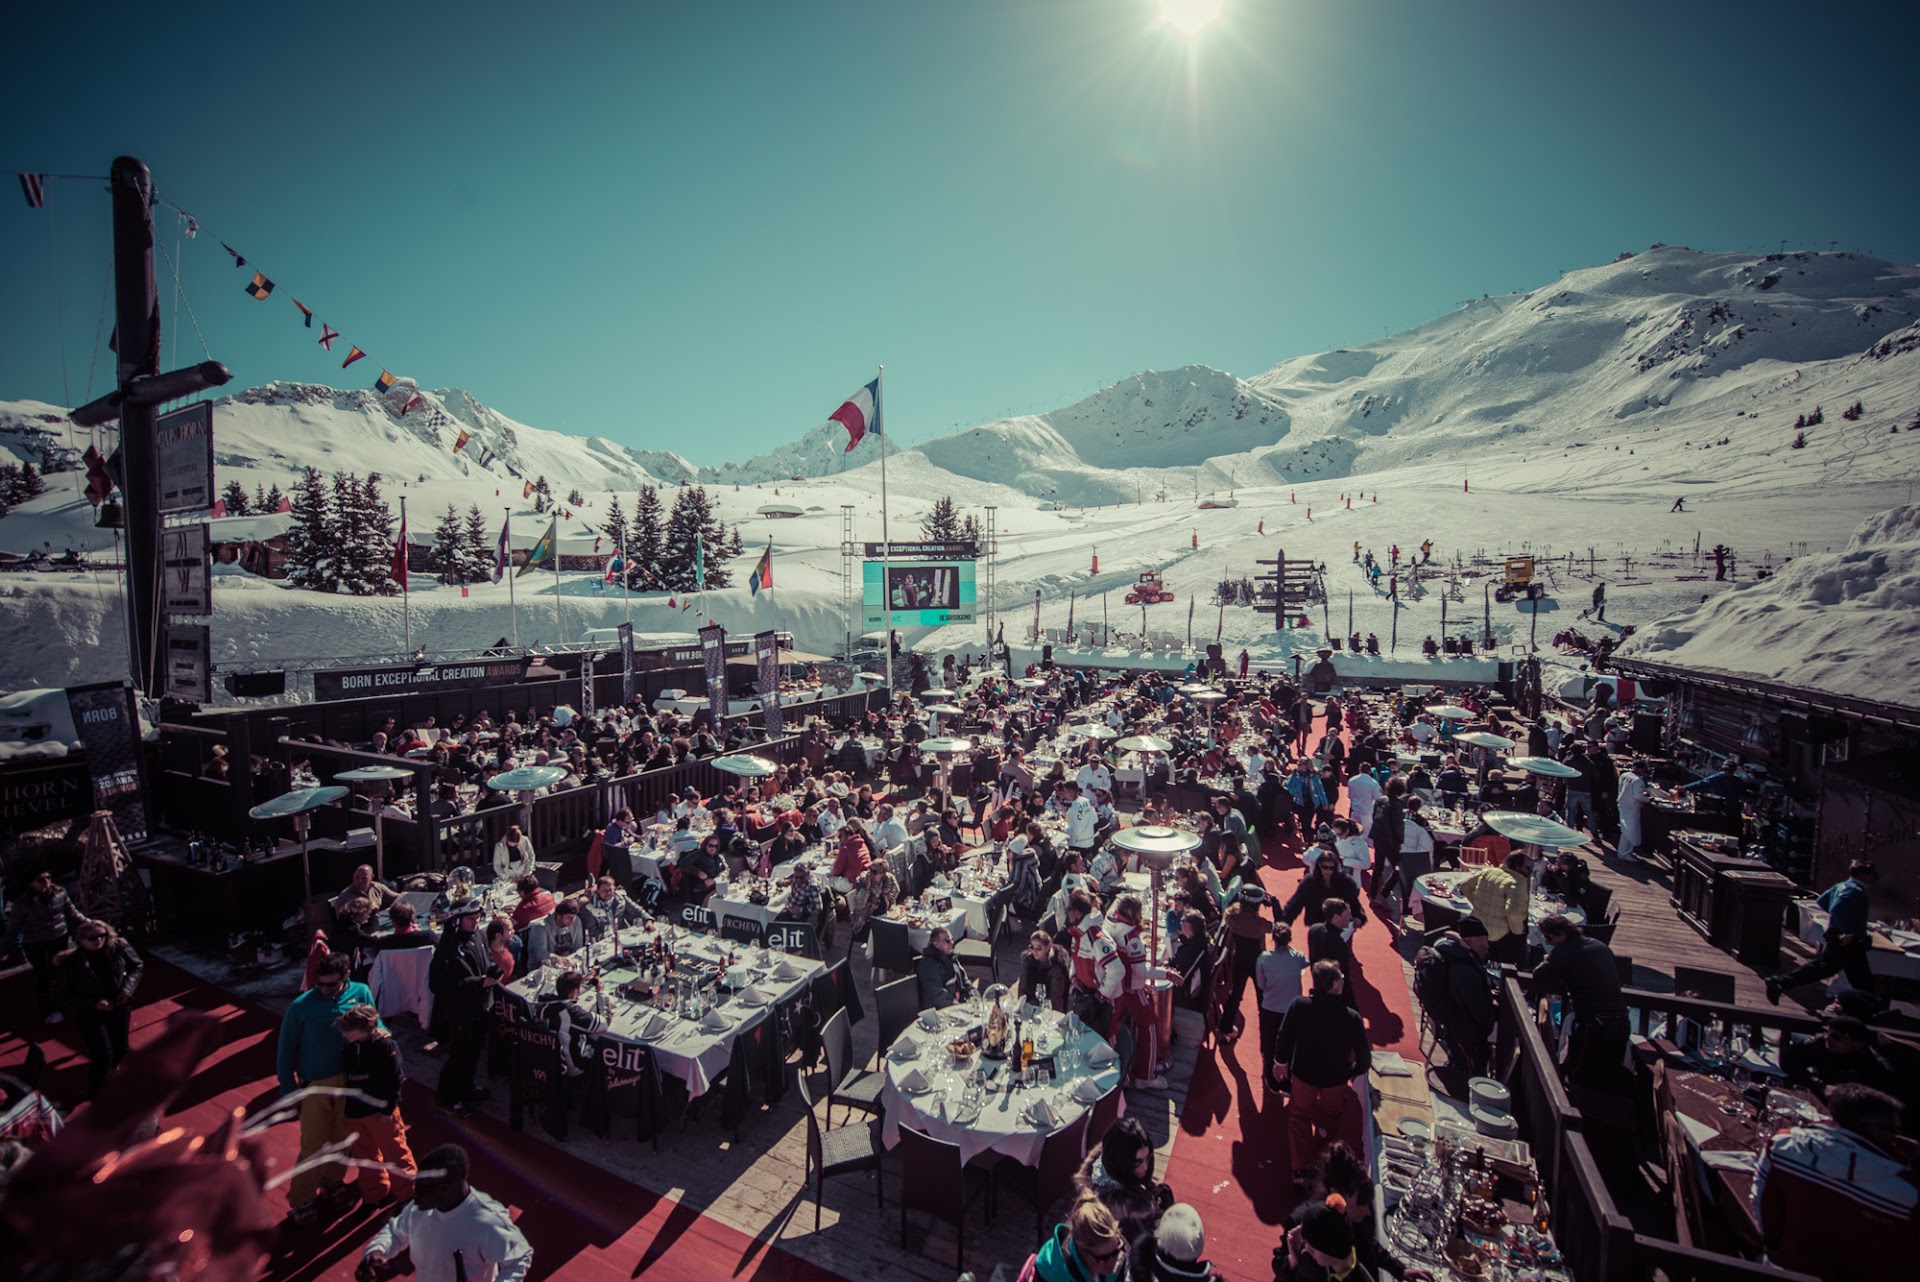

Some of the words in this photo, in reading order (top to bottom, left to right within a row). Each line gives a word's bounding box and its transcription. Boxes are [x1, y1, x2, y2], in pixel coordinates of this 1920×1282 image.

[158, 428, 175, 448] CAP
[179, 419, 205, 442] HORN
[342, 674, 372, 690] BORN
[442, 665, 485, 682] CREATION
[486, 663, 522, 678] AWARDS
[4, 777, 79, 801] HORN
[681, 905, 711, 925] elit
[768, 927, 805, 948] elit
[602, 1042, 646, 1072] elit
